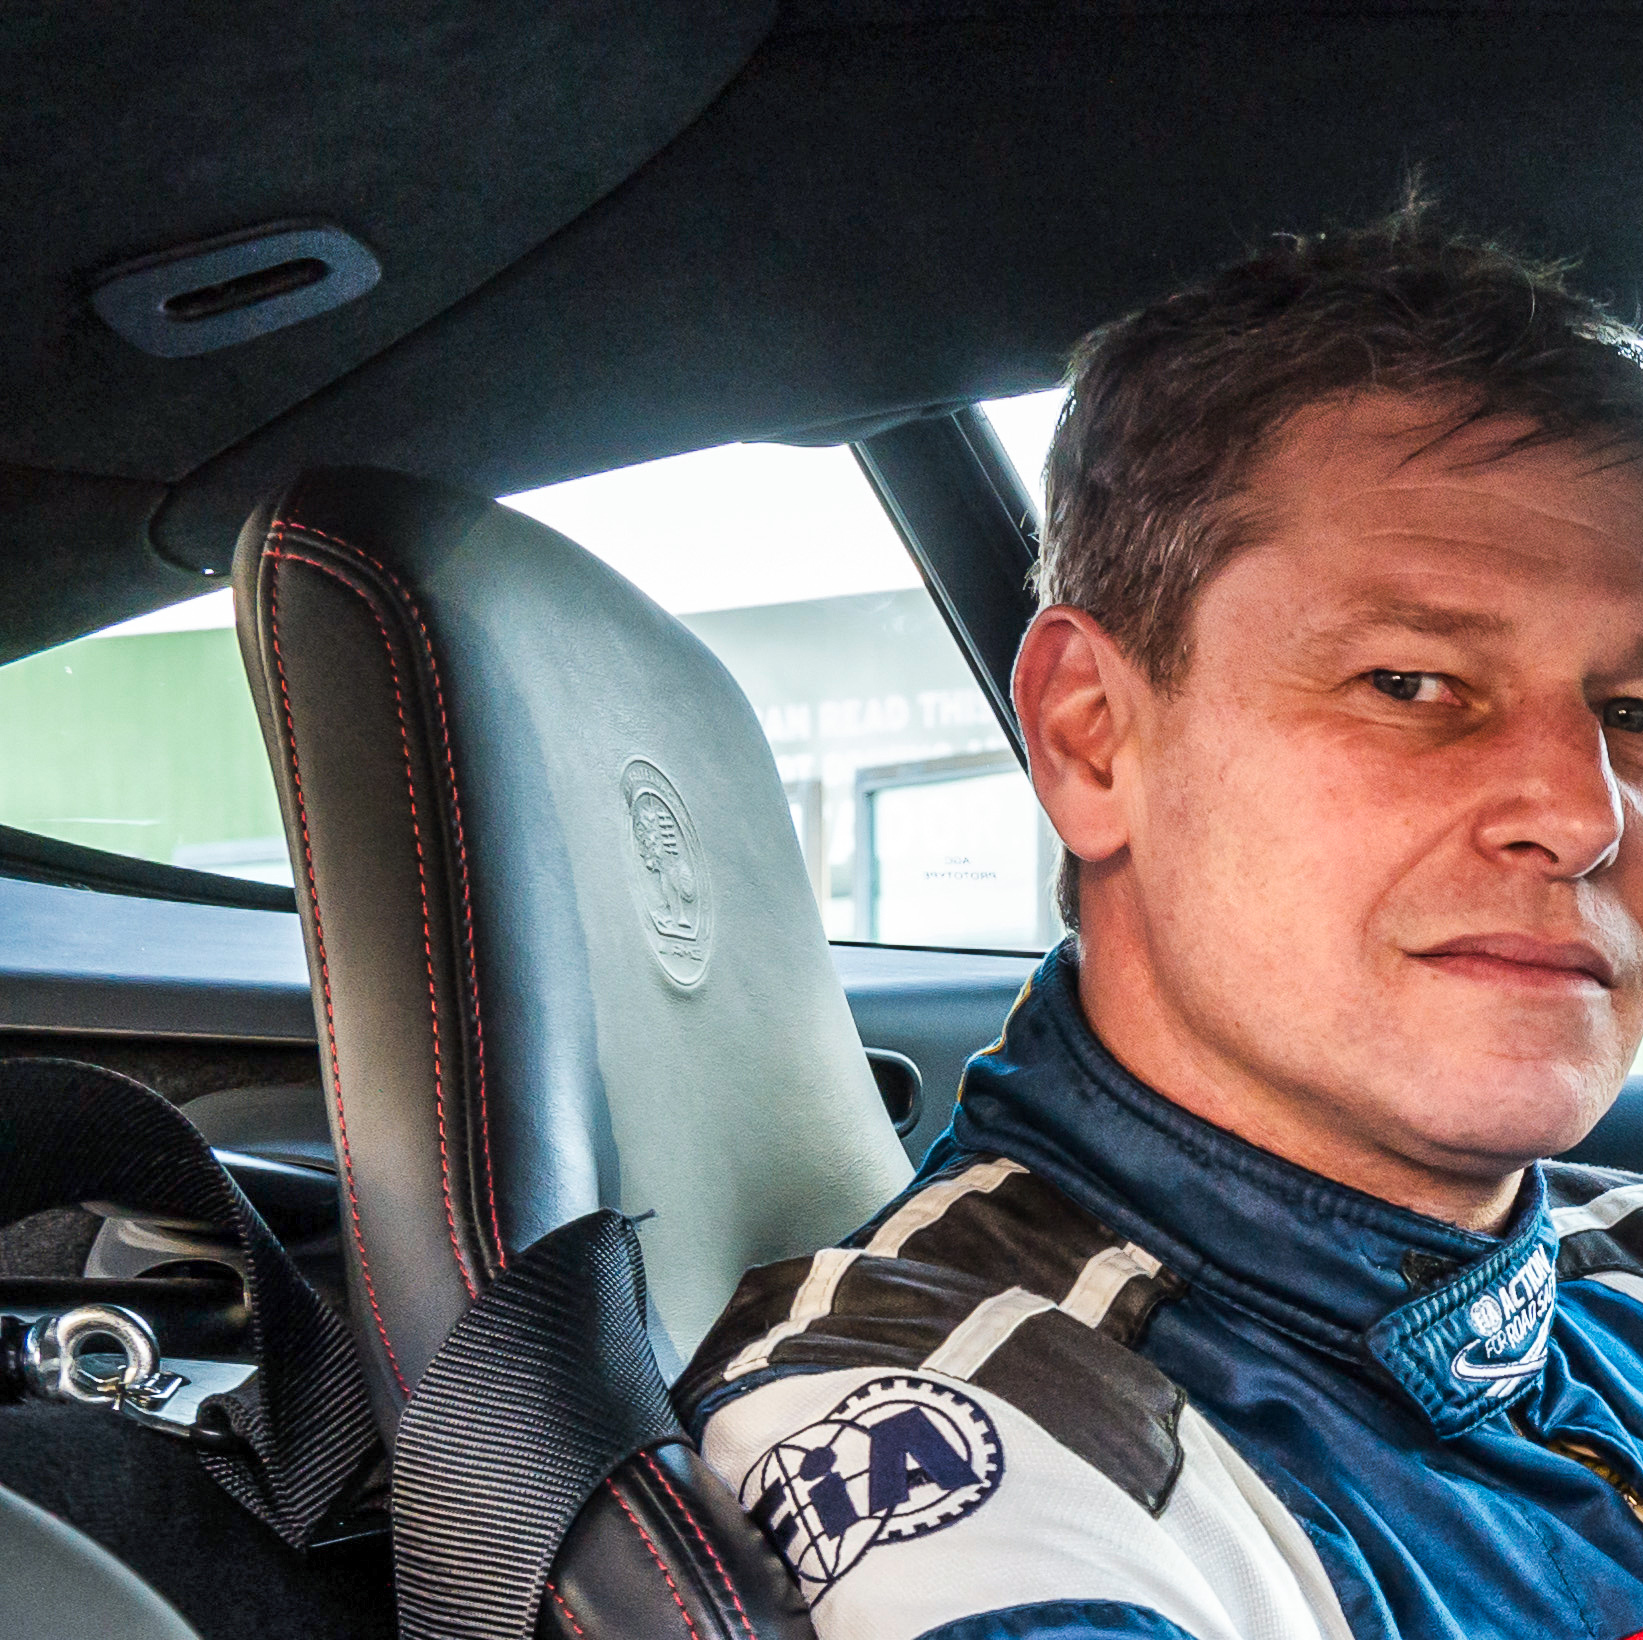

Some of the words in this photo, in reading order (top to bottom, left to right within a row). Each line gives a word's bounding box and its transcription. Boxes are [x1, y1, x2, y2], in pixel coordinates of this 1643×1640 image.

[754, 702, 811, 742] AN
[1498, 1243, 1552, 1320] ACTION
[1485, 1329, 1509, 1359] FOR
[1505, 1299, 1538, 1349] ROAD
